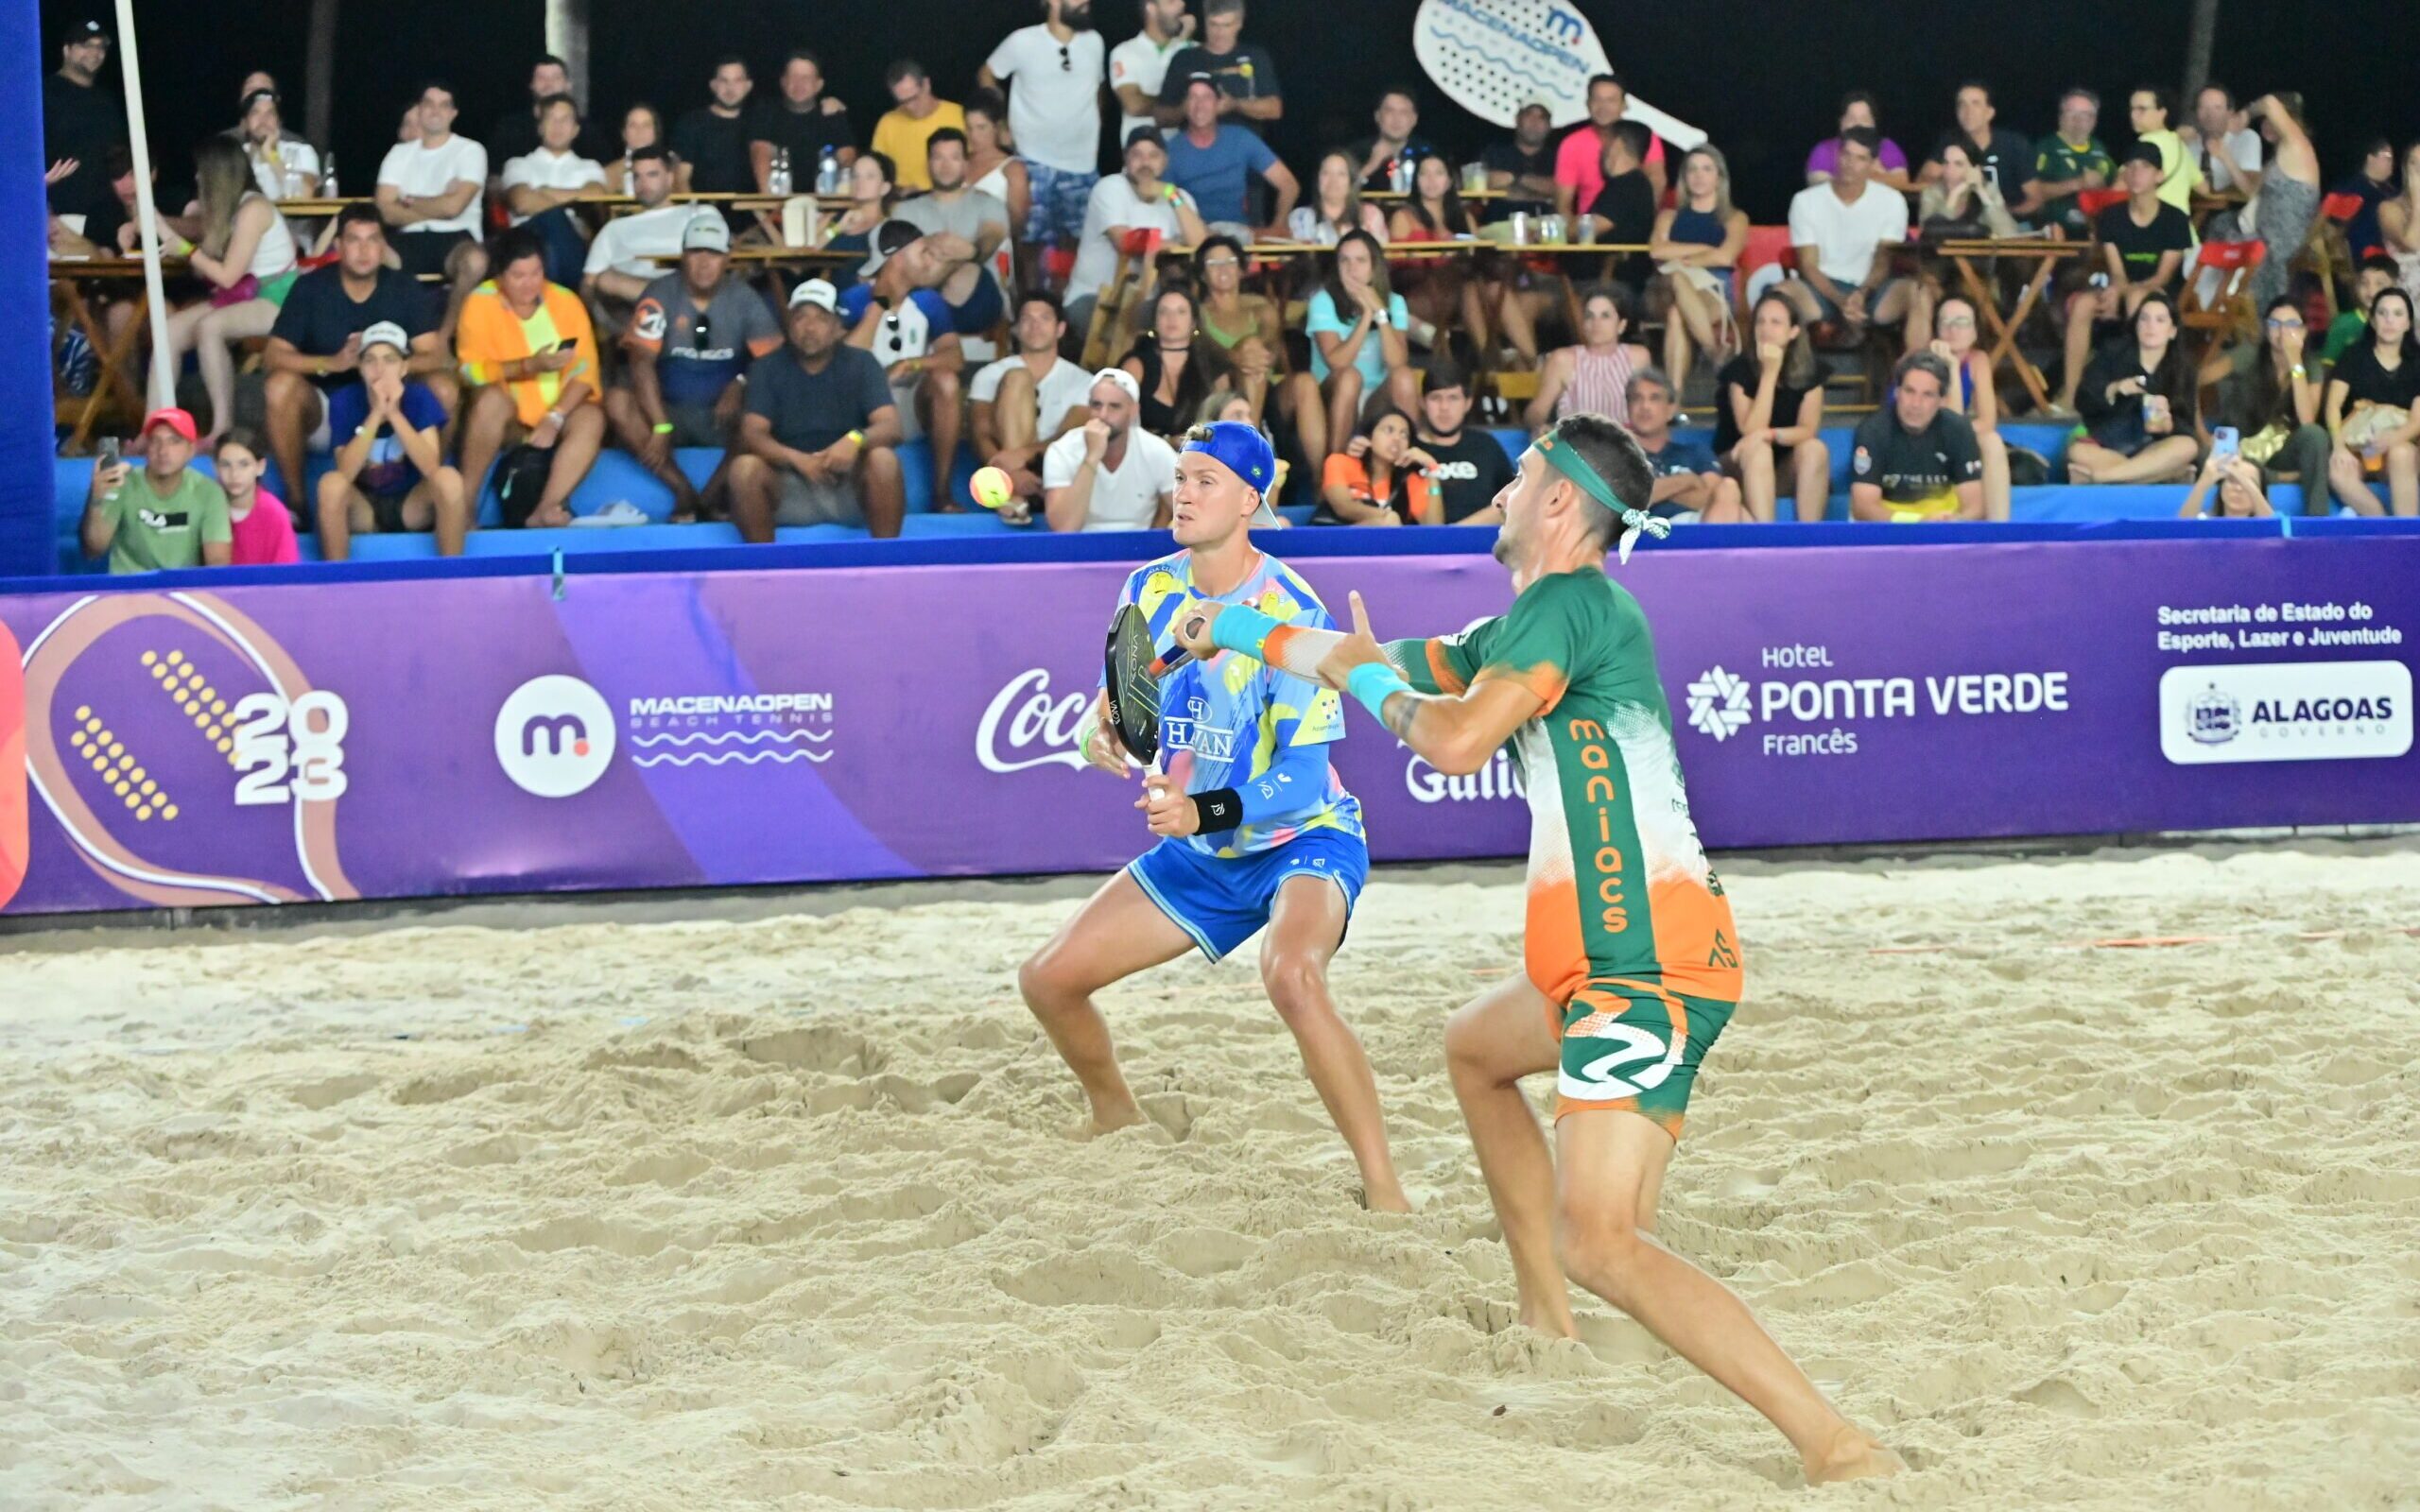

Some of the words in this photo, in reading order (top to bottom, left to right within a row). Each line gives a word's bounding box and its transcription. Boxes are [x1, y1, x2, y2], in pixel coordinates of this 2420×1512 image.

[2158, 604, 2251, 625] Secretaria
[2255, 604, 2278, 622] de
[2282, 602, 2345, 622] Estado
[2158, 630, 2235, 653] Esporte,
[2238, 628, 2290, 648] Lazer
[2292, 631, 2305, 646] e
[2308, 626, 2403, 646] Juventude
[1761, 644, 1834, 667] Hotel
[631, 693, 833, 715] MACENAOPEN
[1761, 679, 1915, 721] PONTA
[1926, 672, 2069, 714] VERDE
[631, 716, 718, 729] BEACH
[735, 713, 834, 726] TENNIS
[2251, 696, 2394, 723] ALAGOAS
[1762, 728, 1858, 755] Francês
[2259, 724, 2386, 738] GOVERNO
